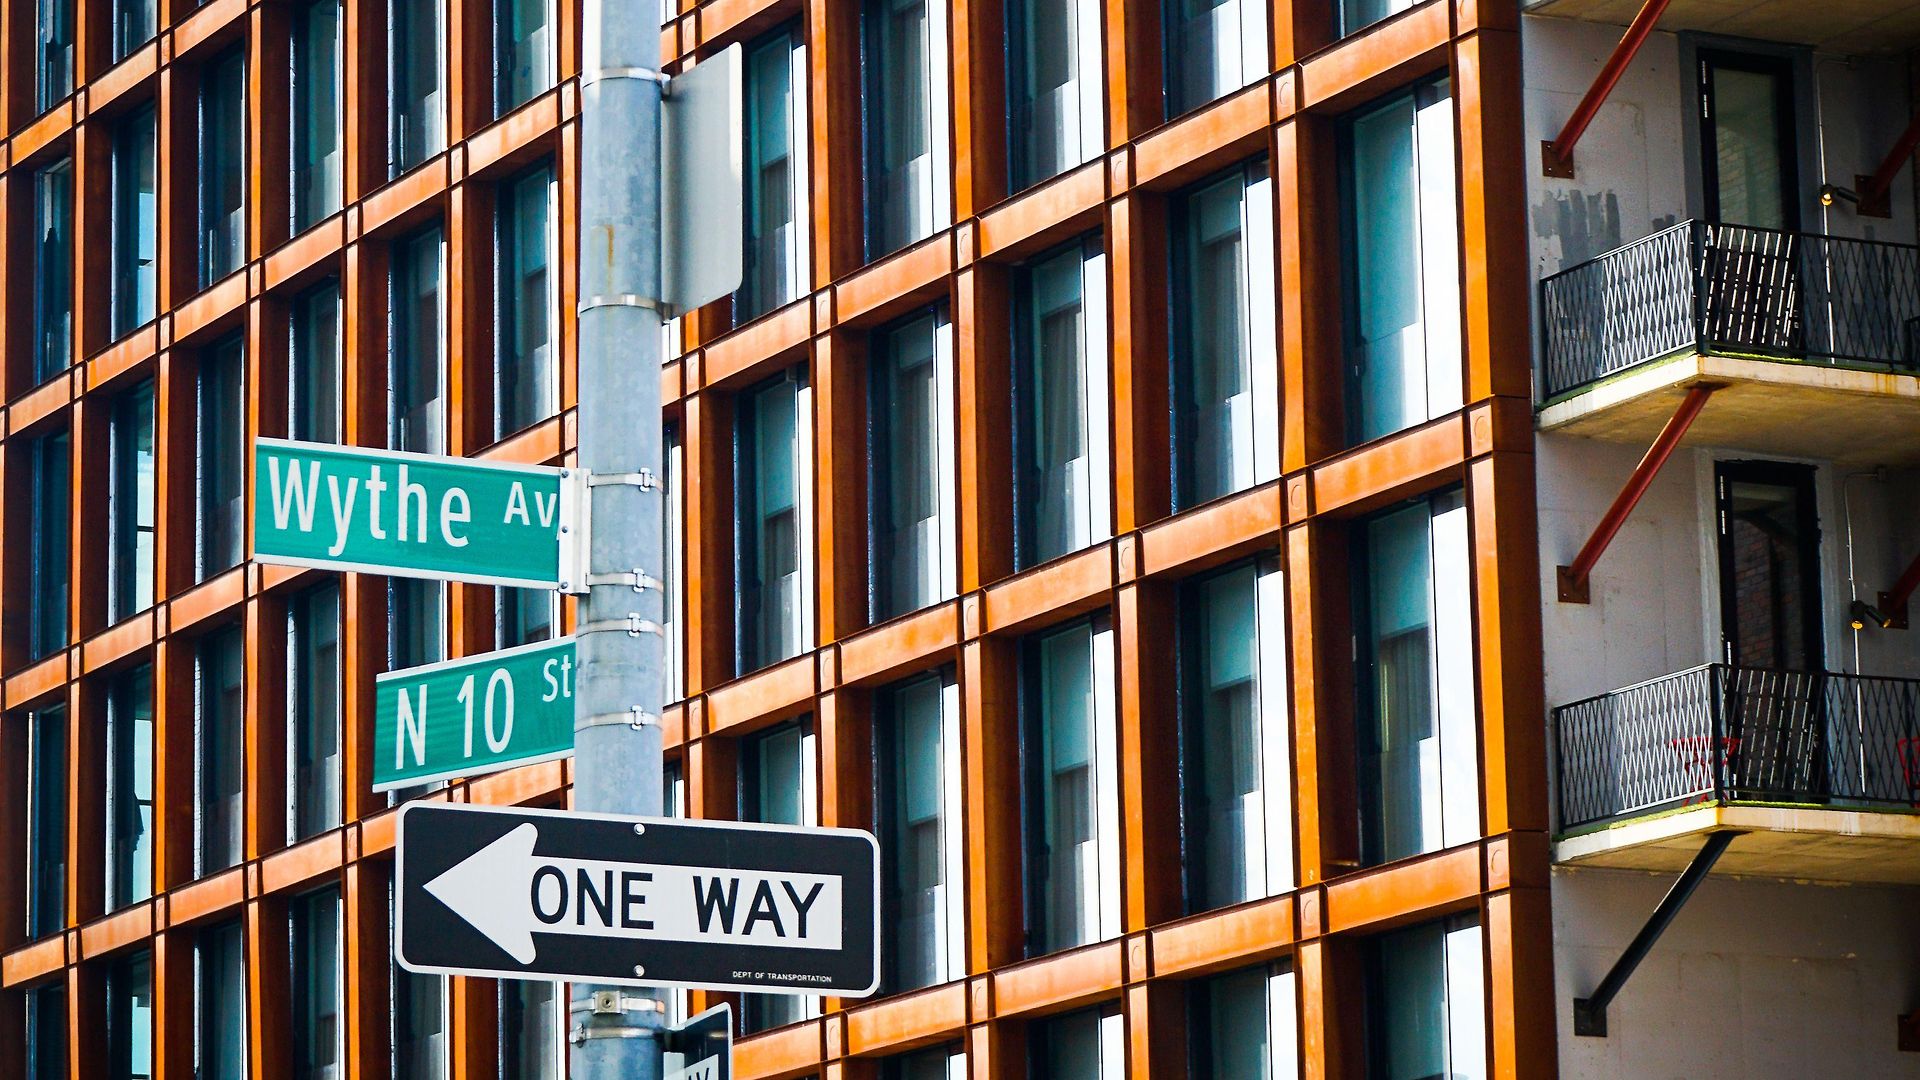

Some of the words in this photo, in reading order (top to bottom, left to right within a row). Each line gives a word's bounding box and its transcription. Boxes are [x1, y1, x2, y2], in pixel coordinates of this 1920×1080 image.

[268, 456, 471, 557] Wythe
[503, 481, 558, 528] Av
[395, 684, 427, 770] N
[457, 668, 514, 758] 10
[542, 655, 572, 702] St
[531, 865, 654, 929] ONE
[692, 876, 824, 938] WAY
[732, 970, 752, 979] DEPT
[767, 972, 833, 983] TRANSPORTATION
